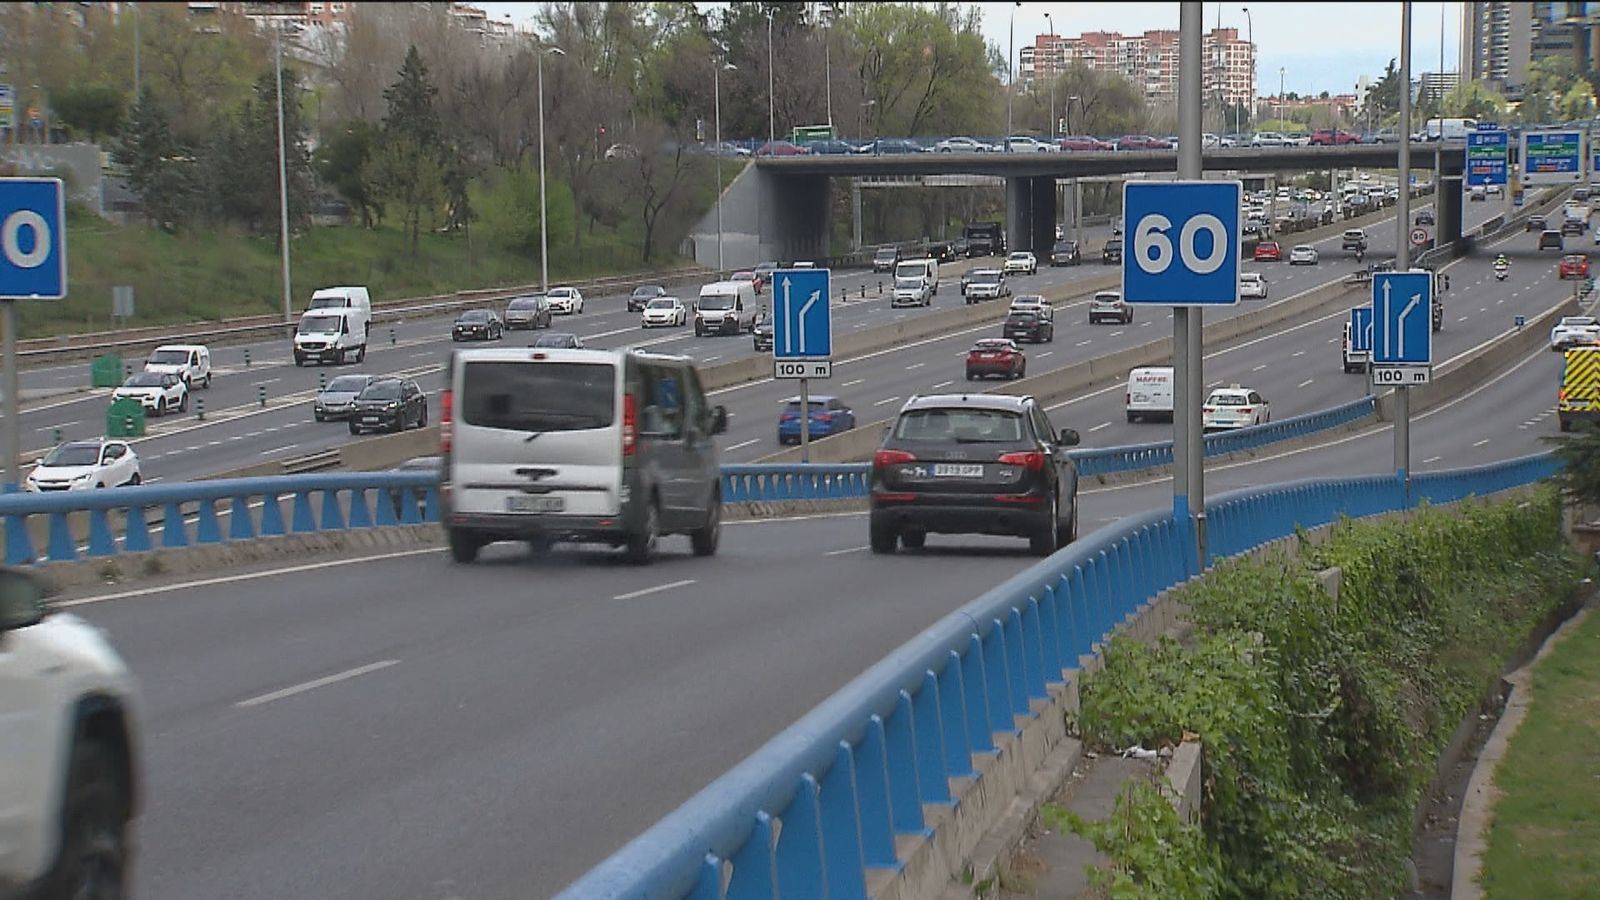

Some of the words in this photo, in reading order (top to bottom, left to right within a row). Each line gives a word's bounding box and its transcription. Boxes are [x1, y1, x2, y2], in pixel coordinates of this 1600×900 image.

[1134, 213, 1228, 274] 60
[779, 364, 804, 375] 100
[815, 366, 826, 375] m
[1378, 370, 1403, 381] 100
[1413, 372, 1426, 382] m
